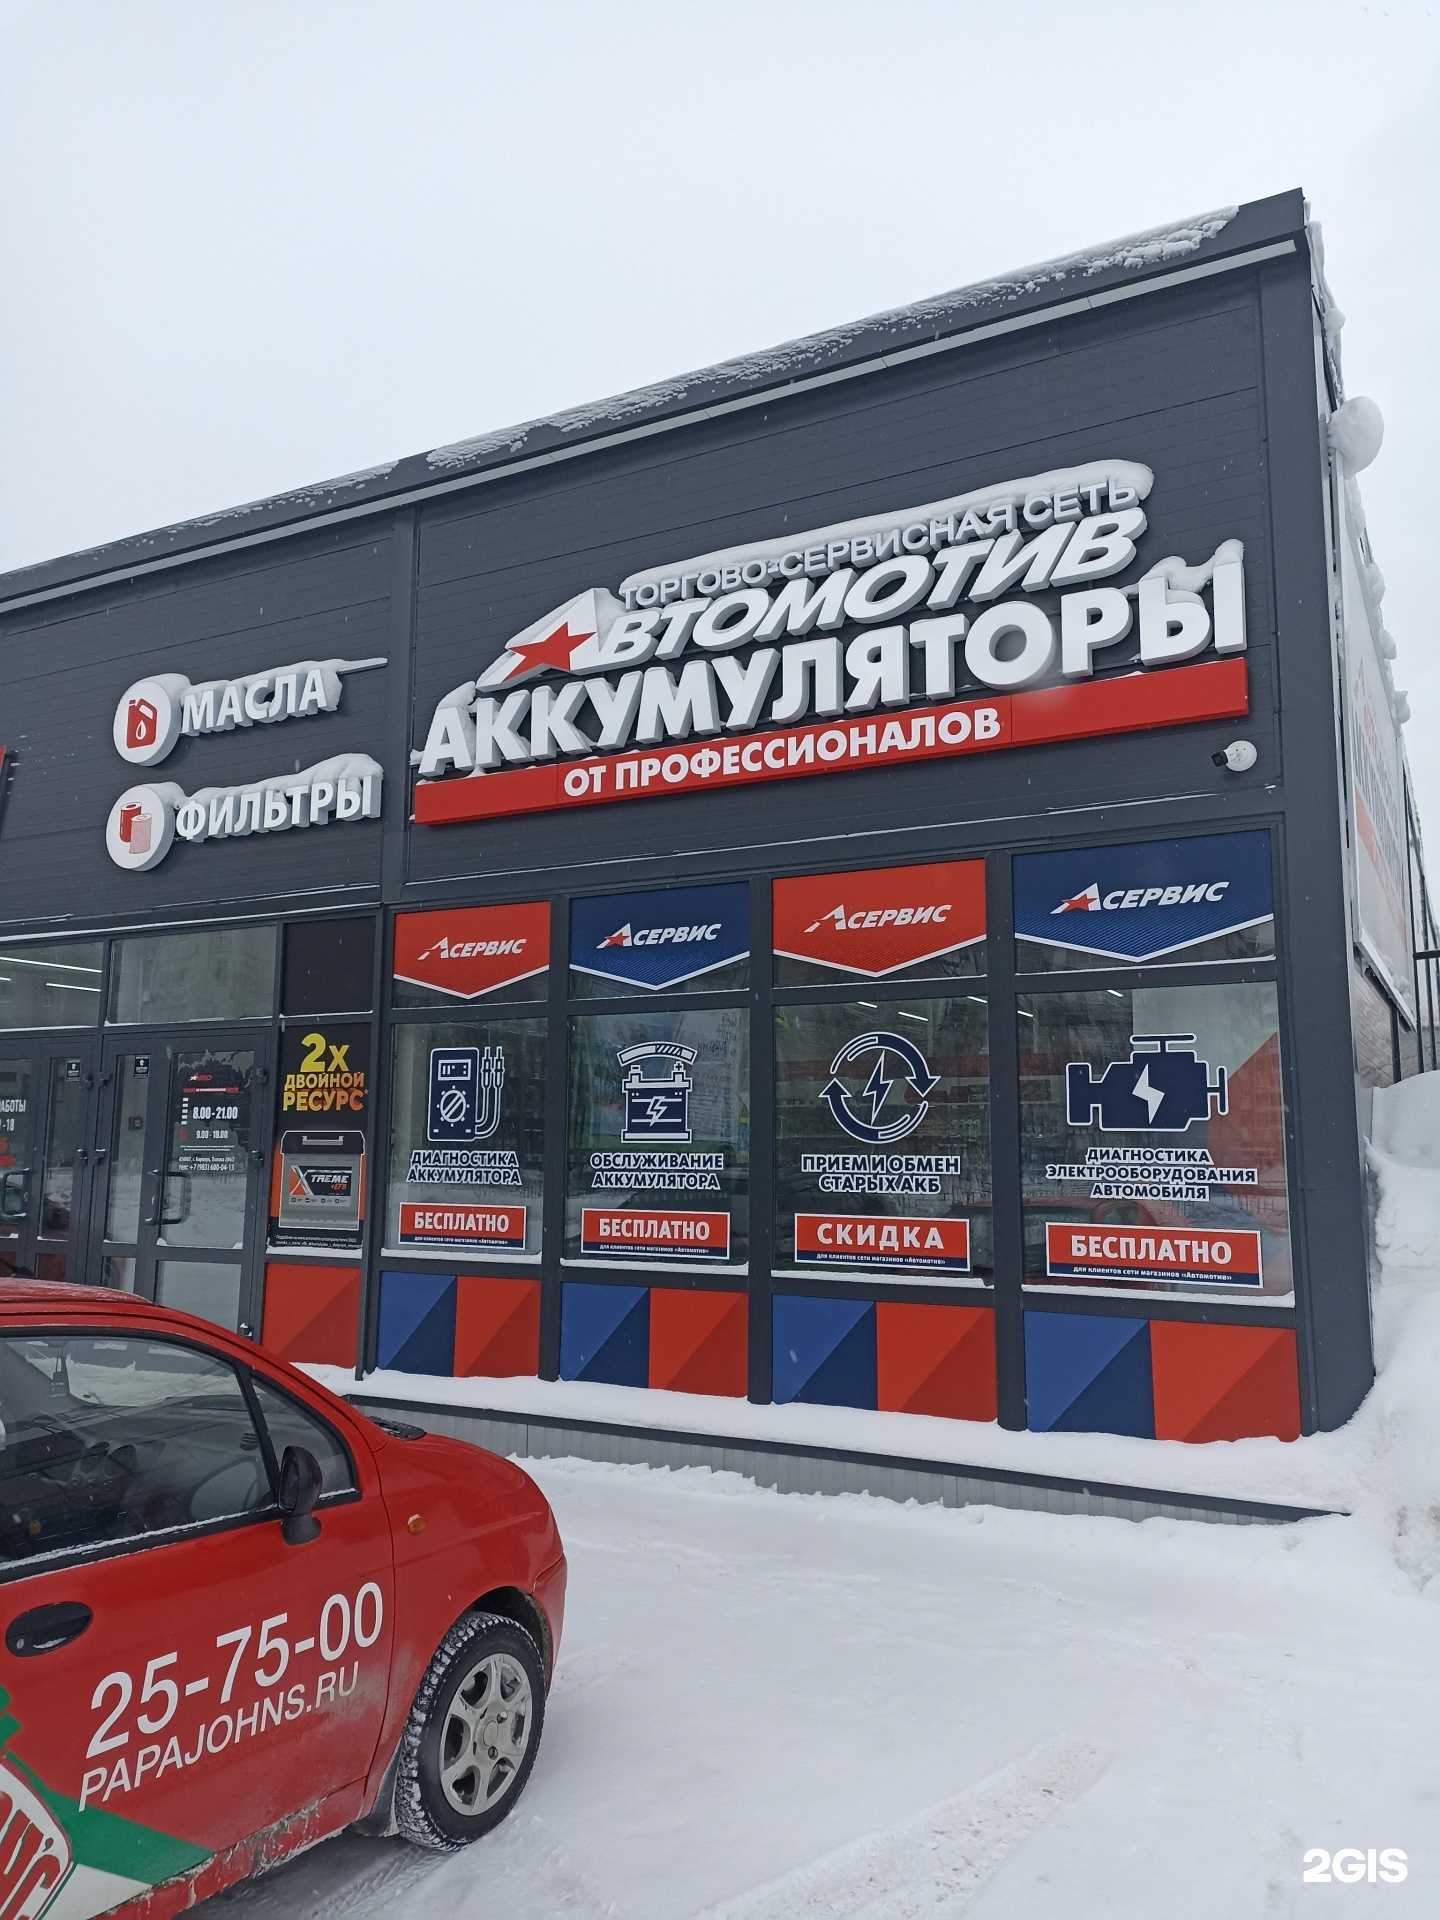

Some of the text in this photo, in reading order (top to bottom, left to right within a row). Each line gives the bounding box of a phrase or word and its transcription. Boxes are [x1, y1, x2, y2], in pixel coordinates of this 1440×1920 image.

[622, 479, 1139, 611] ТОРГОВО-СЕРВИСНАЯ СЕТЬ
[476, 507, 1148, 691] АВТОМОТИВ
[418, 561, 1247, 776] АККУМУЛЯТОРЫ
[180, 669, 336, 736] МАСЛА
[564, 708, 1001, 797] ОТ ПРОФЕССИОНАЛОВ
[176, 775, 382, 841] ФИЛЬТРЫ
[284, 1072, 365, 1091] ДВОЙНОЙ
[411, 1150, 519, 1167] ДИАГНОСТИКА
[590, 1153, 723, 1170] ОБСЛУЖИВАНИЕ
[801, 1154, 960, 1174] ПРИЕМ И ОБМЕН
[1086, 1147, 1214, 1165] ДИАГНОСТИКА
[406, 1167, 522, 1185] АККУМУЛЯТОРА
[592, 1172, 720, 1189] АККУМУЛЯТОРА
[819, 1174, 941, 1194] СТАРЫХ АКБ
[1046, 1164, 1258, 1184] ЭЛЕКТРООБОРУДОВАНИЯ
[1090, 1182, 1209, 1200] АВТОМОБИЛЯ
[414, 1211, 509, 1233] БЕСПЛАТНО
[599, 1218, 710, 1241] БЕСПЛАТНО
[816, 1223, 945, 1252] СКИДКА
[1071, 1234, 1232, 1265] БЕСПЛАТНО
[1088, 1266, 1122, 1275] клиентов
[1140, 1270, 1180, 1278] магазинов
[85, 1582, 383, 1759] 25-75-00
[78, 1660, 359, 1812] PAPAJOHNS.RU
